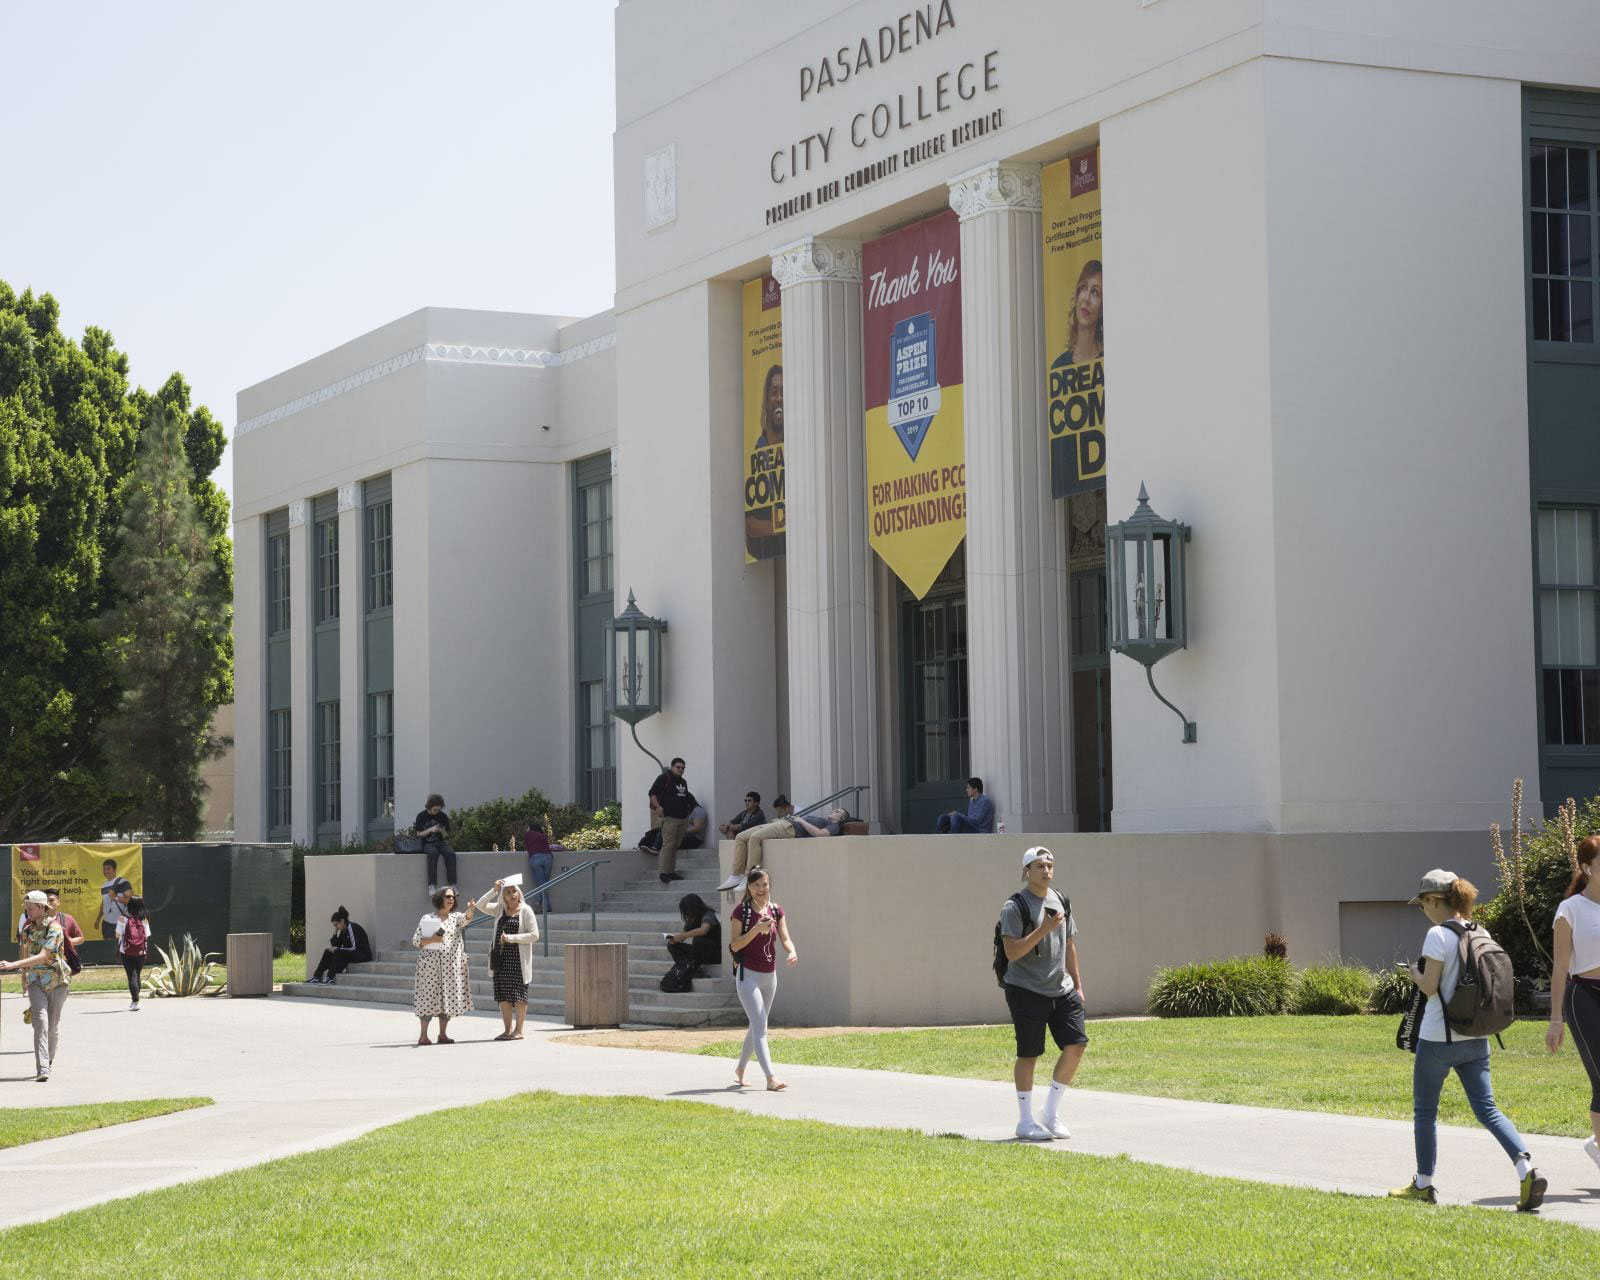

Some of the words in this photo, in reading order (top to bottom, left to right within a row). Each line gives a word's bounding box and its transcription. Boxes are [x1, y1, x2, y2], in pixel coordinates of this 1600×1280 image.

[800, 0, 955, 102] PASADENA
[770, 127, 833, 184] CITY
[851, 50, 998, 148] COLLEGE
[765, 192, 811, 226] PASADENA
[817, 180, 839, 205] AREA
[845, 153, 898, 193] COMMUNITY
[904, 134, 945, 168] COLLEGE
[952, 108, 1002, 148] DISTRICT
[1045, 229, 1076, 244] Certificate
[1051, 244, 1065, 254] Free
[868, 266, 920, 311] Thank
[926, 248, 957, 291] You
[896, 340, 927, 362] ASPEN
[896, 354, 928, 375] PRIZE
[898, 399, 915, 417] TOP
[917, 396, 929, 412] 10
[872, 481, 891, 507] FOR
[893, 469, 939, 501] MAKING
[942, 463, 966, 490] PCC
[873, 492, 967, 537] OUTSTANDING!
[20, 868, 40, 876] Your
[42, 868, 68, 876] future
[69, 867, 77, 875] is
[20, 877, 40, 887] right
[41, 877, 72, 885] around
[74, 877, 89, 885] the
